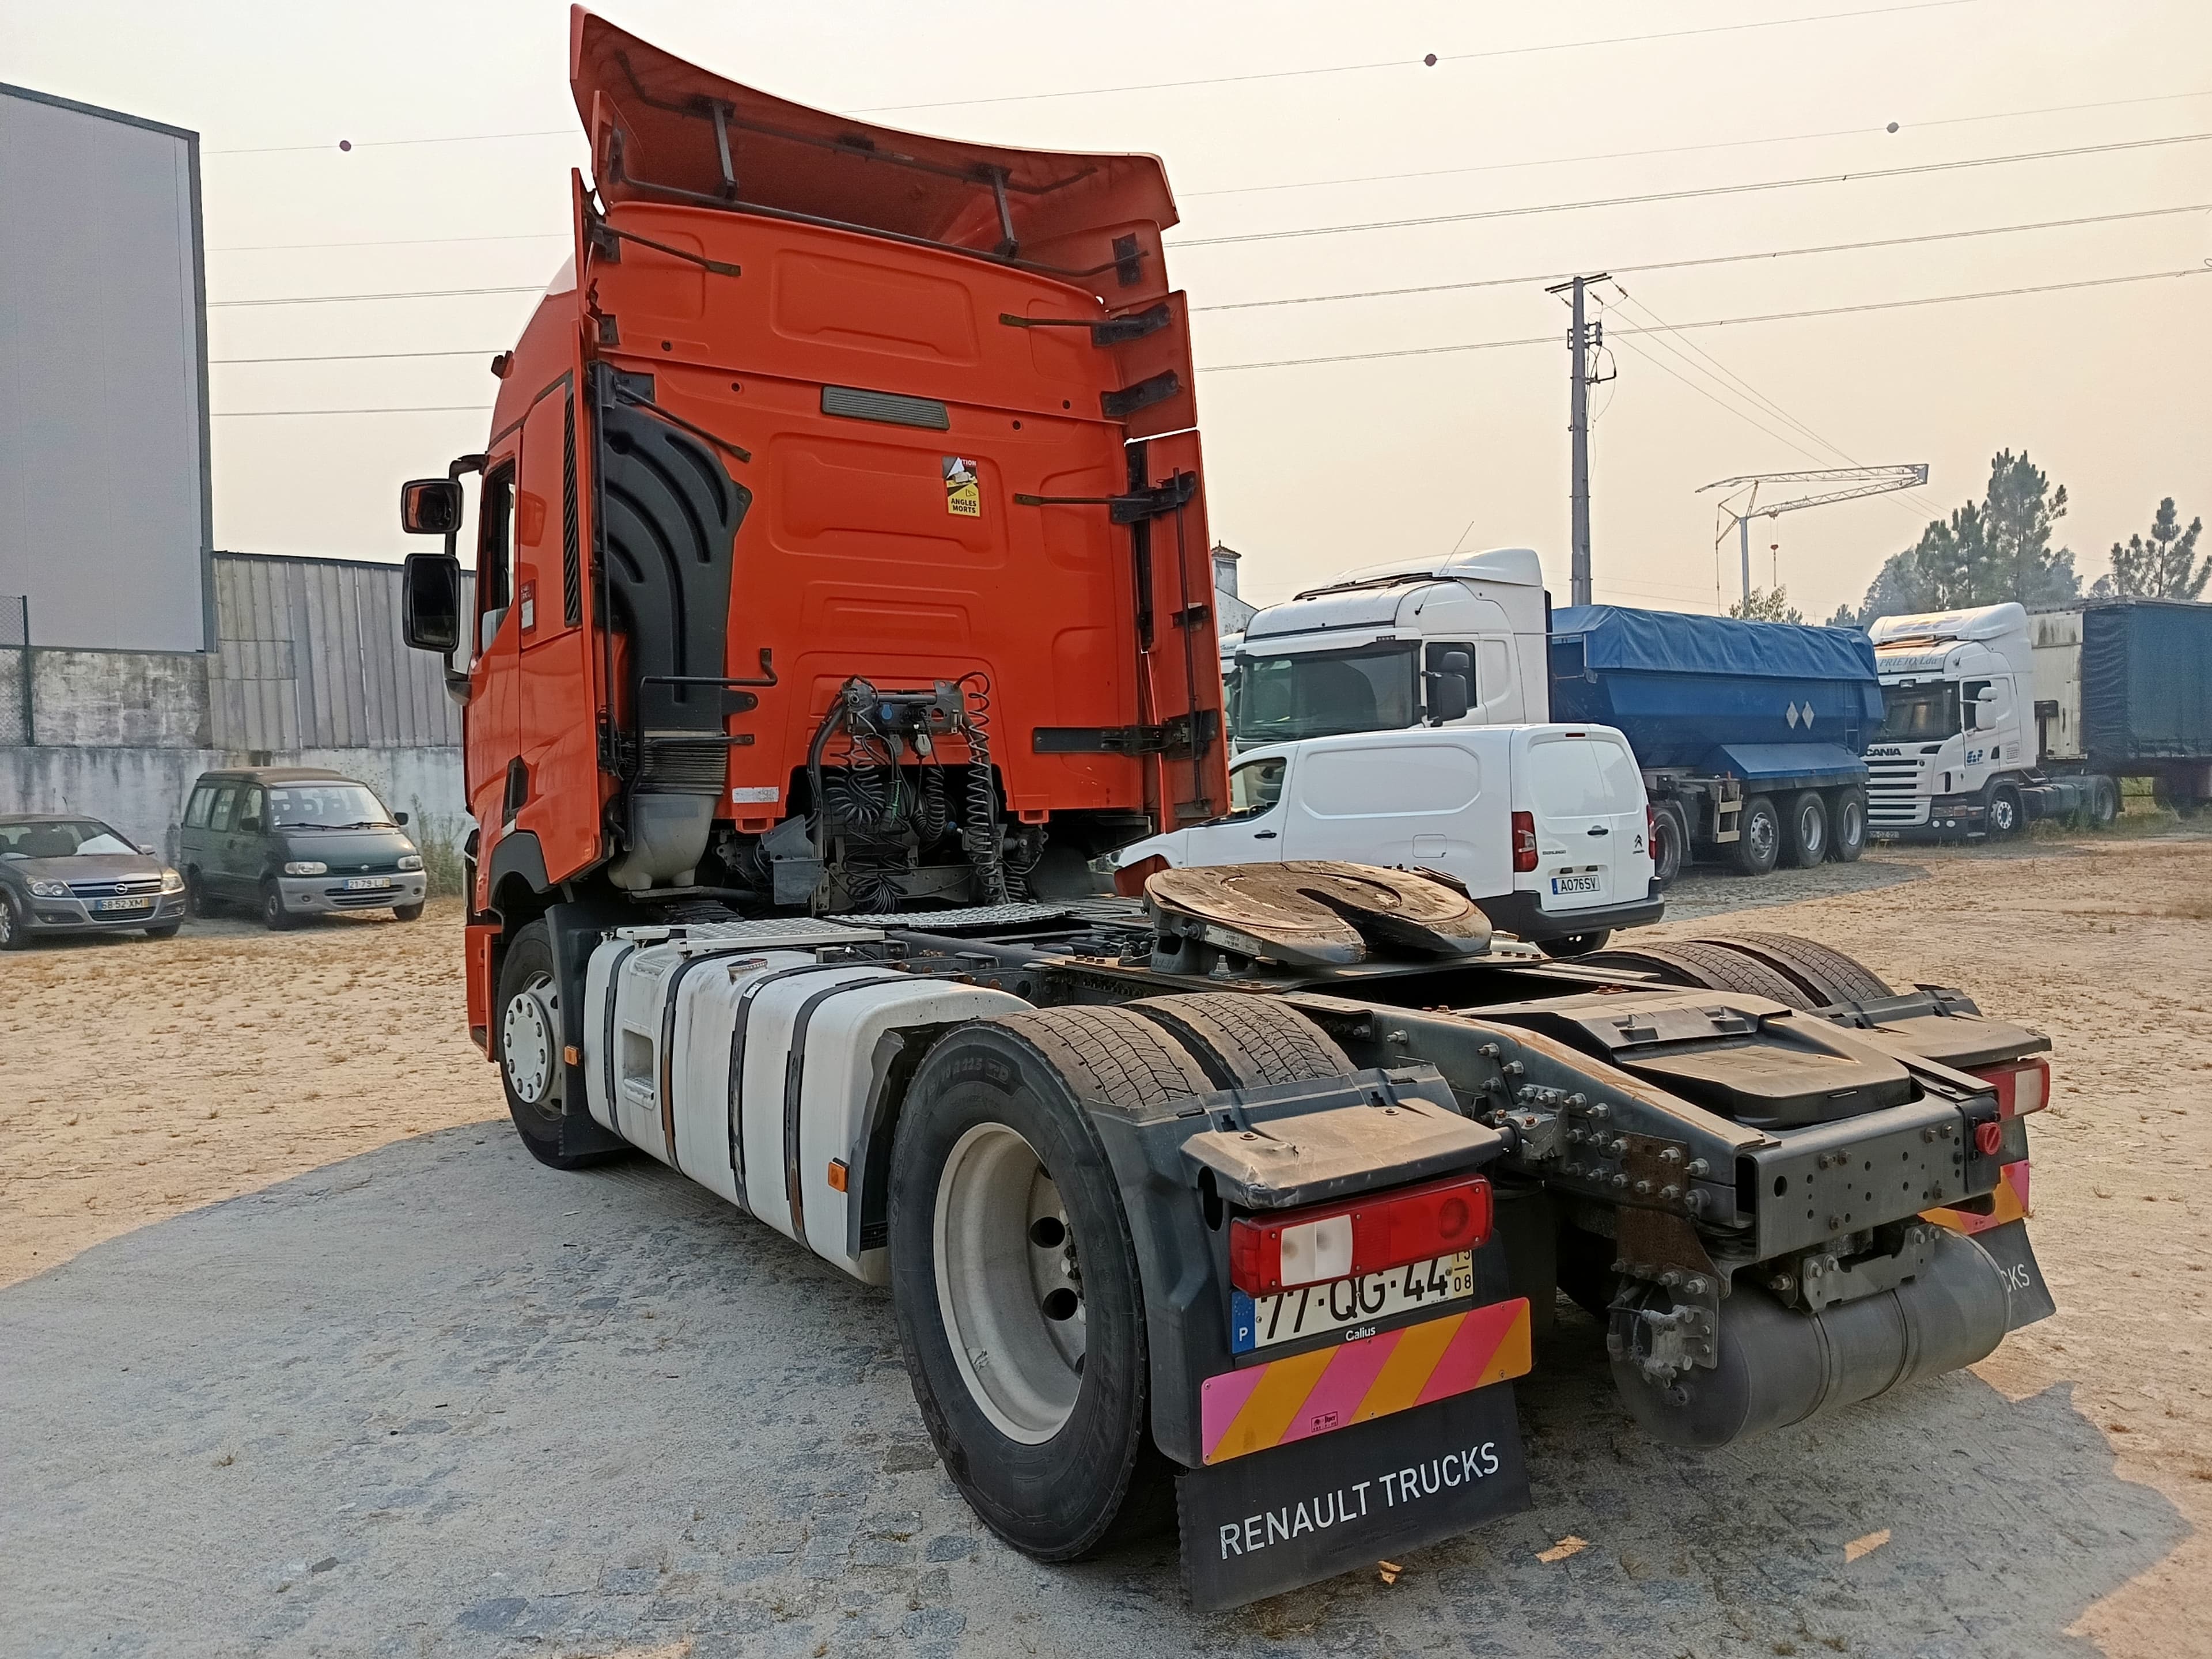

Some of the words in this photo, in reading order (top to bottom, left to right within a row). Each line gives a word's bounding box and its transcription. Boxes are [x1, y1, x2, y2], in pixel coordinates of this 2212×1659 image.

[951, 498, 977, 506] ANGLES
[953, 505, 976, 513] MORTS
[1864, 748, 1902, 756] CANIA
[1454, 1274, 1472, 1293] 08
[1239, 1327, 1248, 1342] P
[1345, 1326, 1376, 1342] Galius
[1219, 1480, 1371, 1560] RENAULT
[1379, 1441, 1499, 1508] TRUCKS
